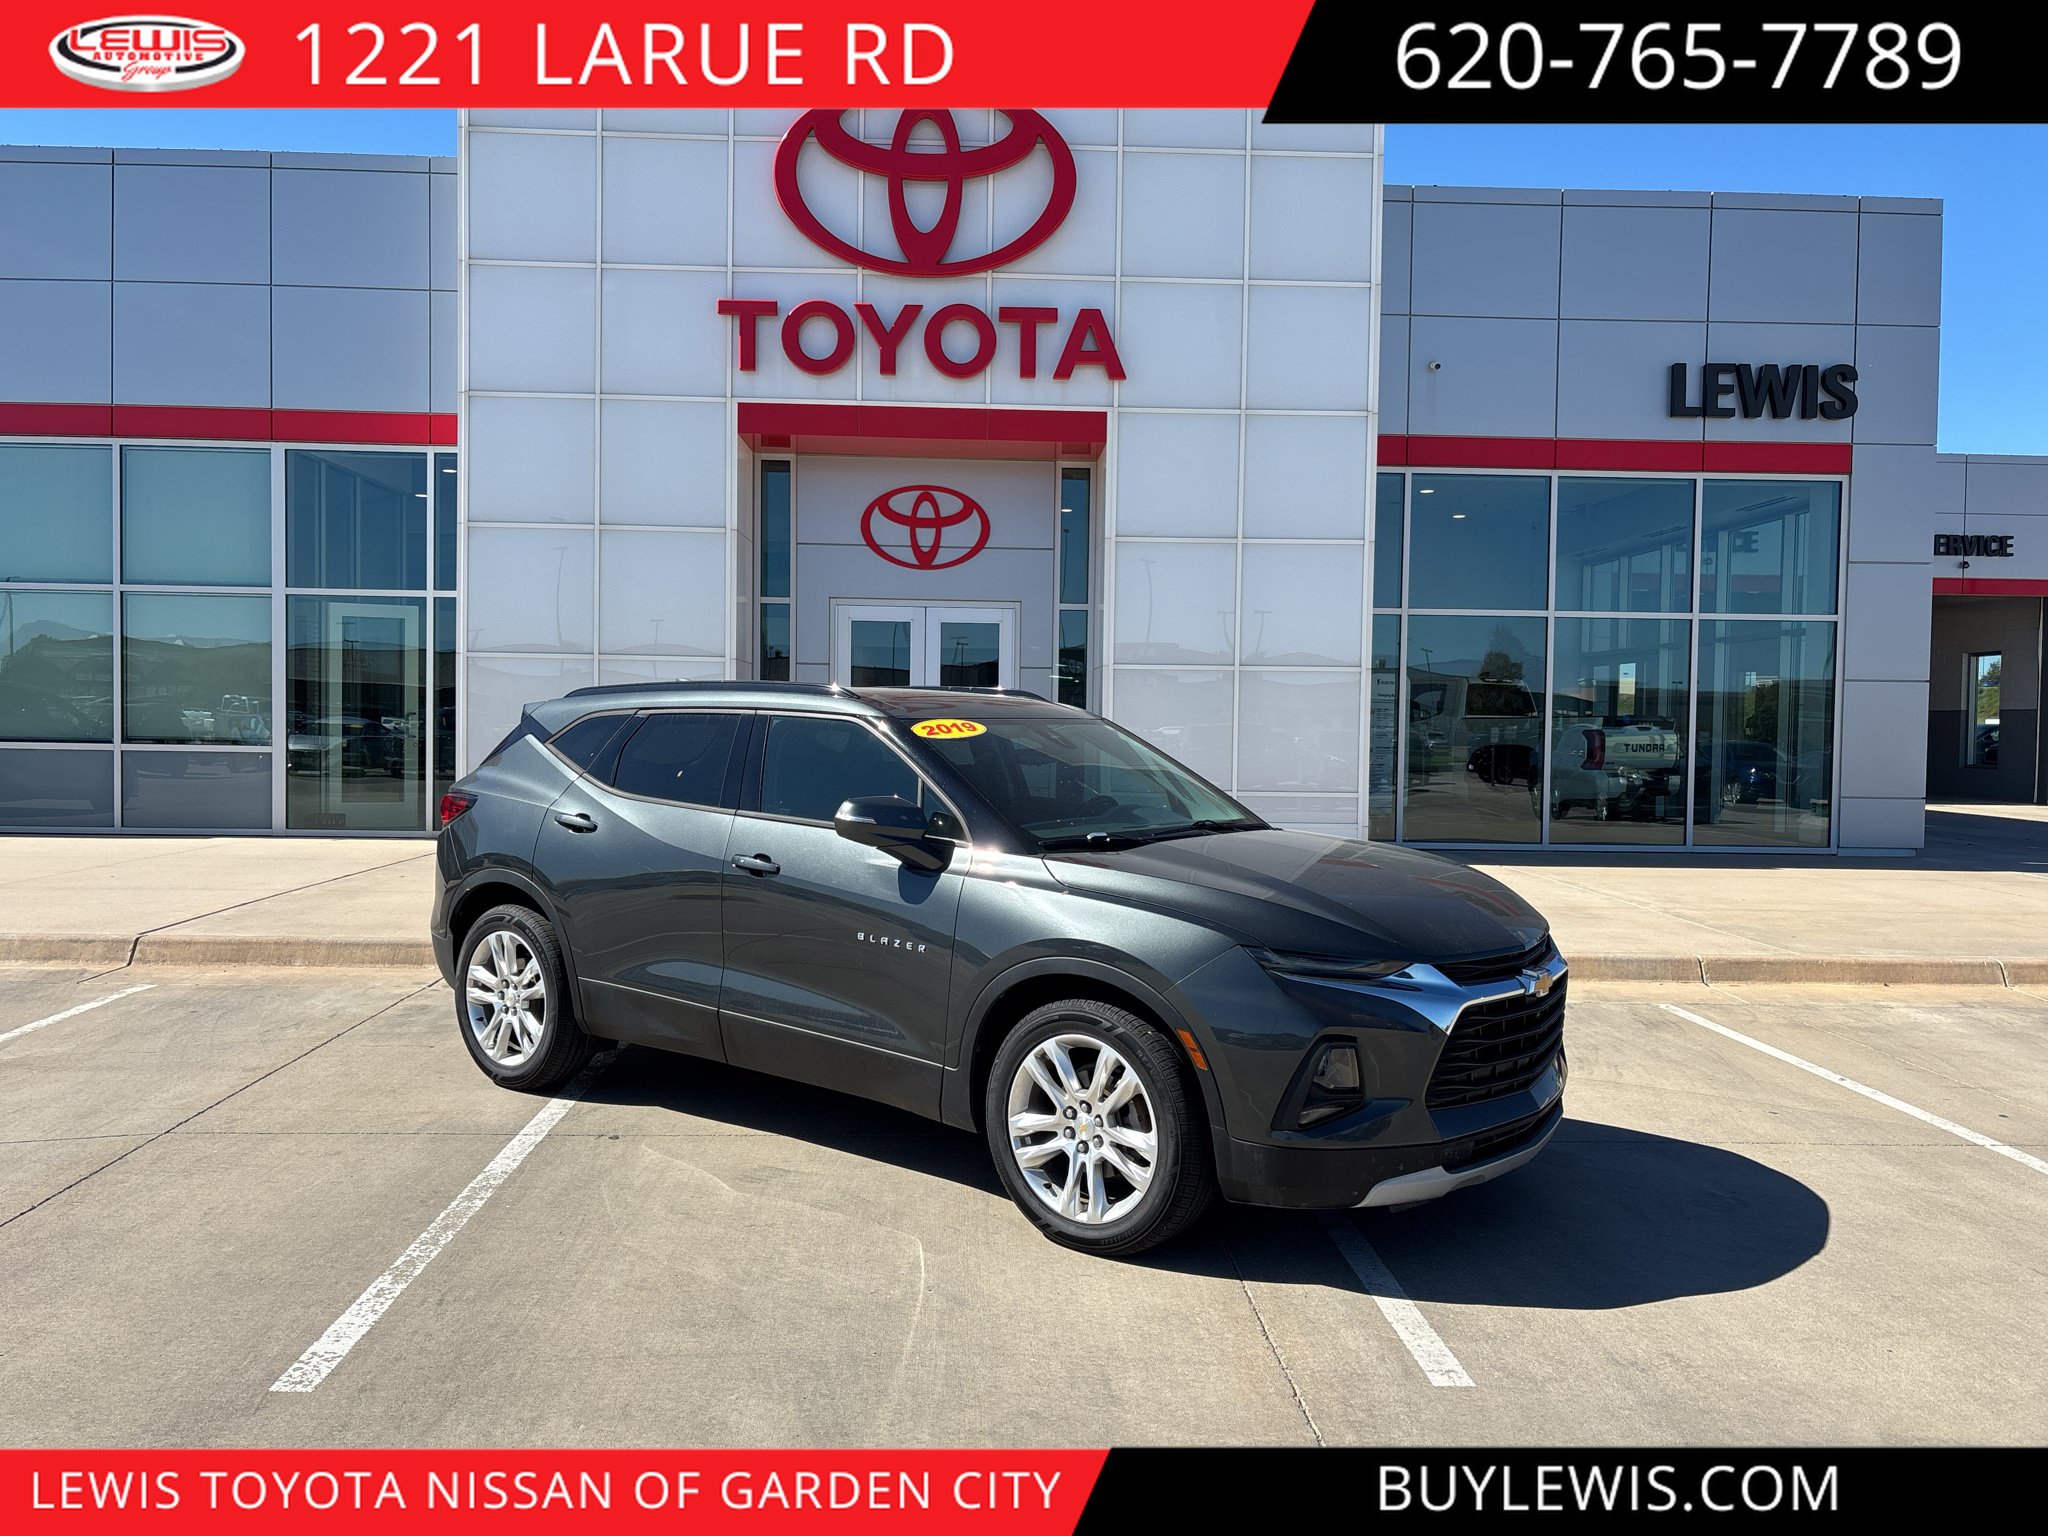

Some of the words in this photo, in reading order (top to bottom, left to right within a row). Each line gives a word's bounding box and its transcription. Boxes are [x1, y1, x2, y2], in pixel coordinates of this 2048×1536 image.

[717, 298, 1127, 381] TOYOTA
[1669, 362, 1859, 421] LEWIS
[1934, 534, 2015, 557] ERVICE
[920, 722, 978, 737] 2019
[1623, 742, 1665, 754] TUNDRA
[857, 931, 927, 954] BLAZER
